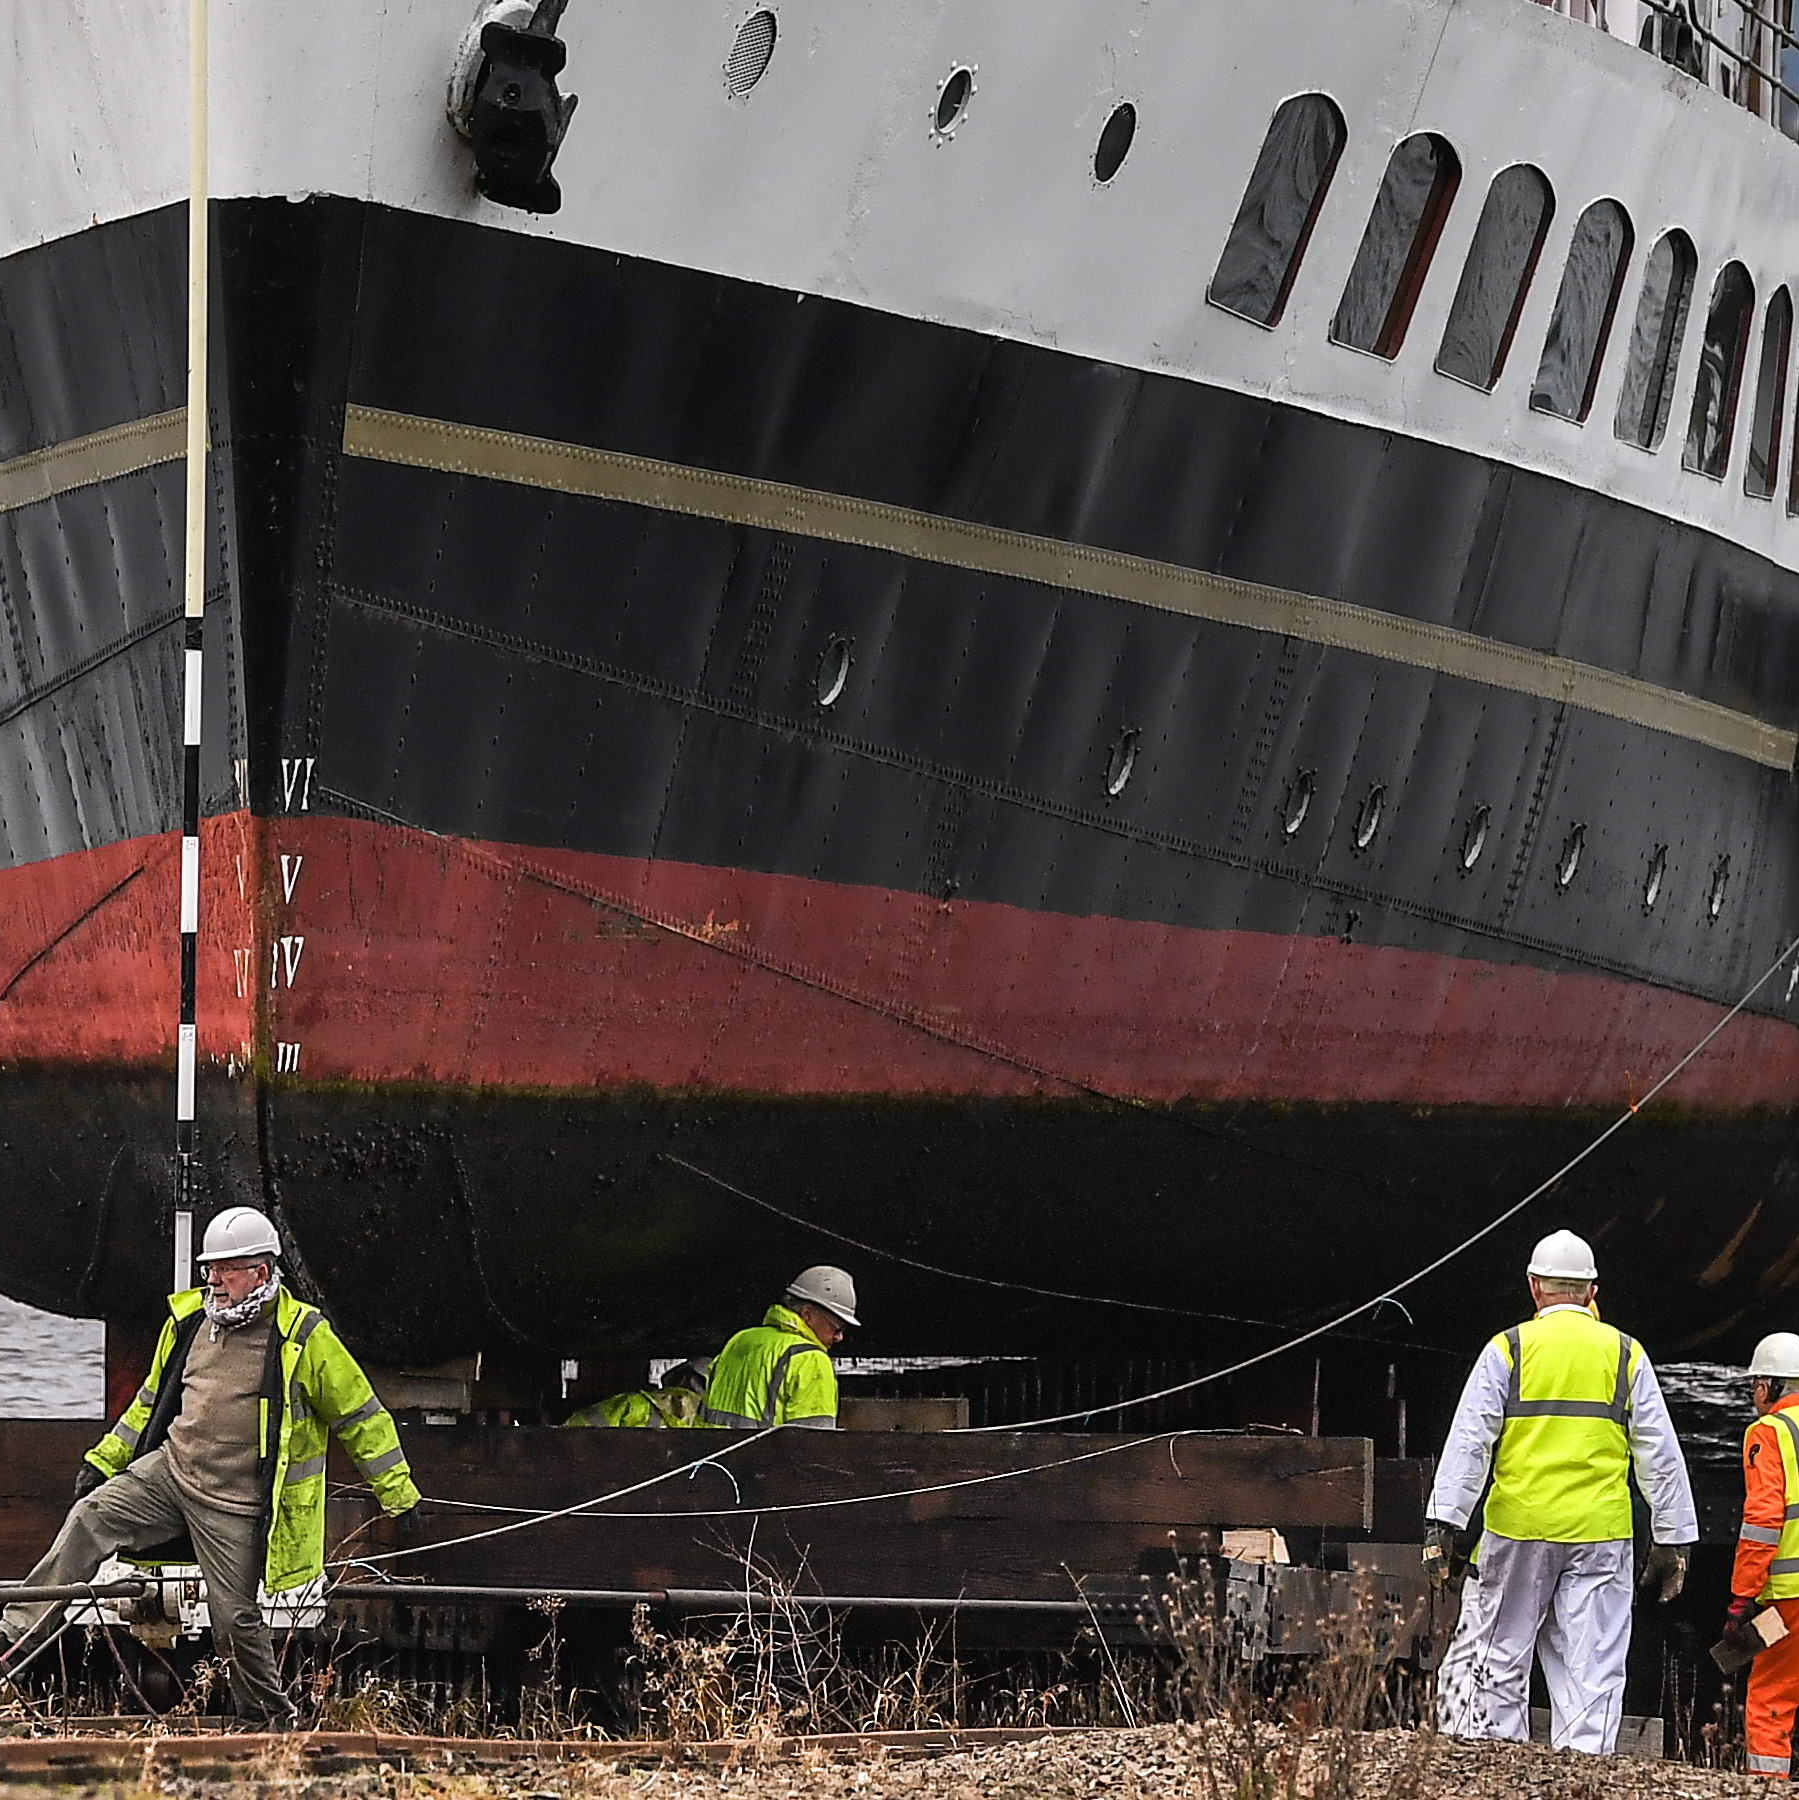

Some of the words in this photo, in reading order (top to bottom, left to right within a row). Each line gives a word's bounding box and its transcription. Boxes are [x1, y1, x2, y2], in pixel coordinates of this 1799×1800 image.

[280, 757, 316, 813] VI
[280, 855, 304, 904] V
[271, 935, 305, 989] IV
[277, 1041, 301, 1073] III
